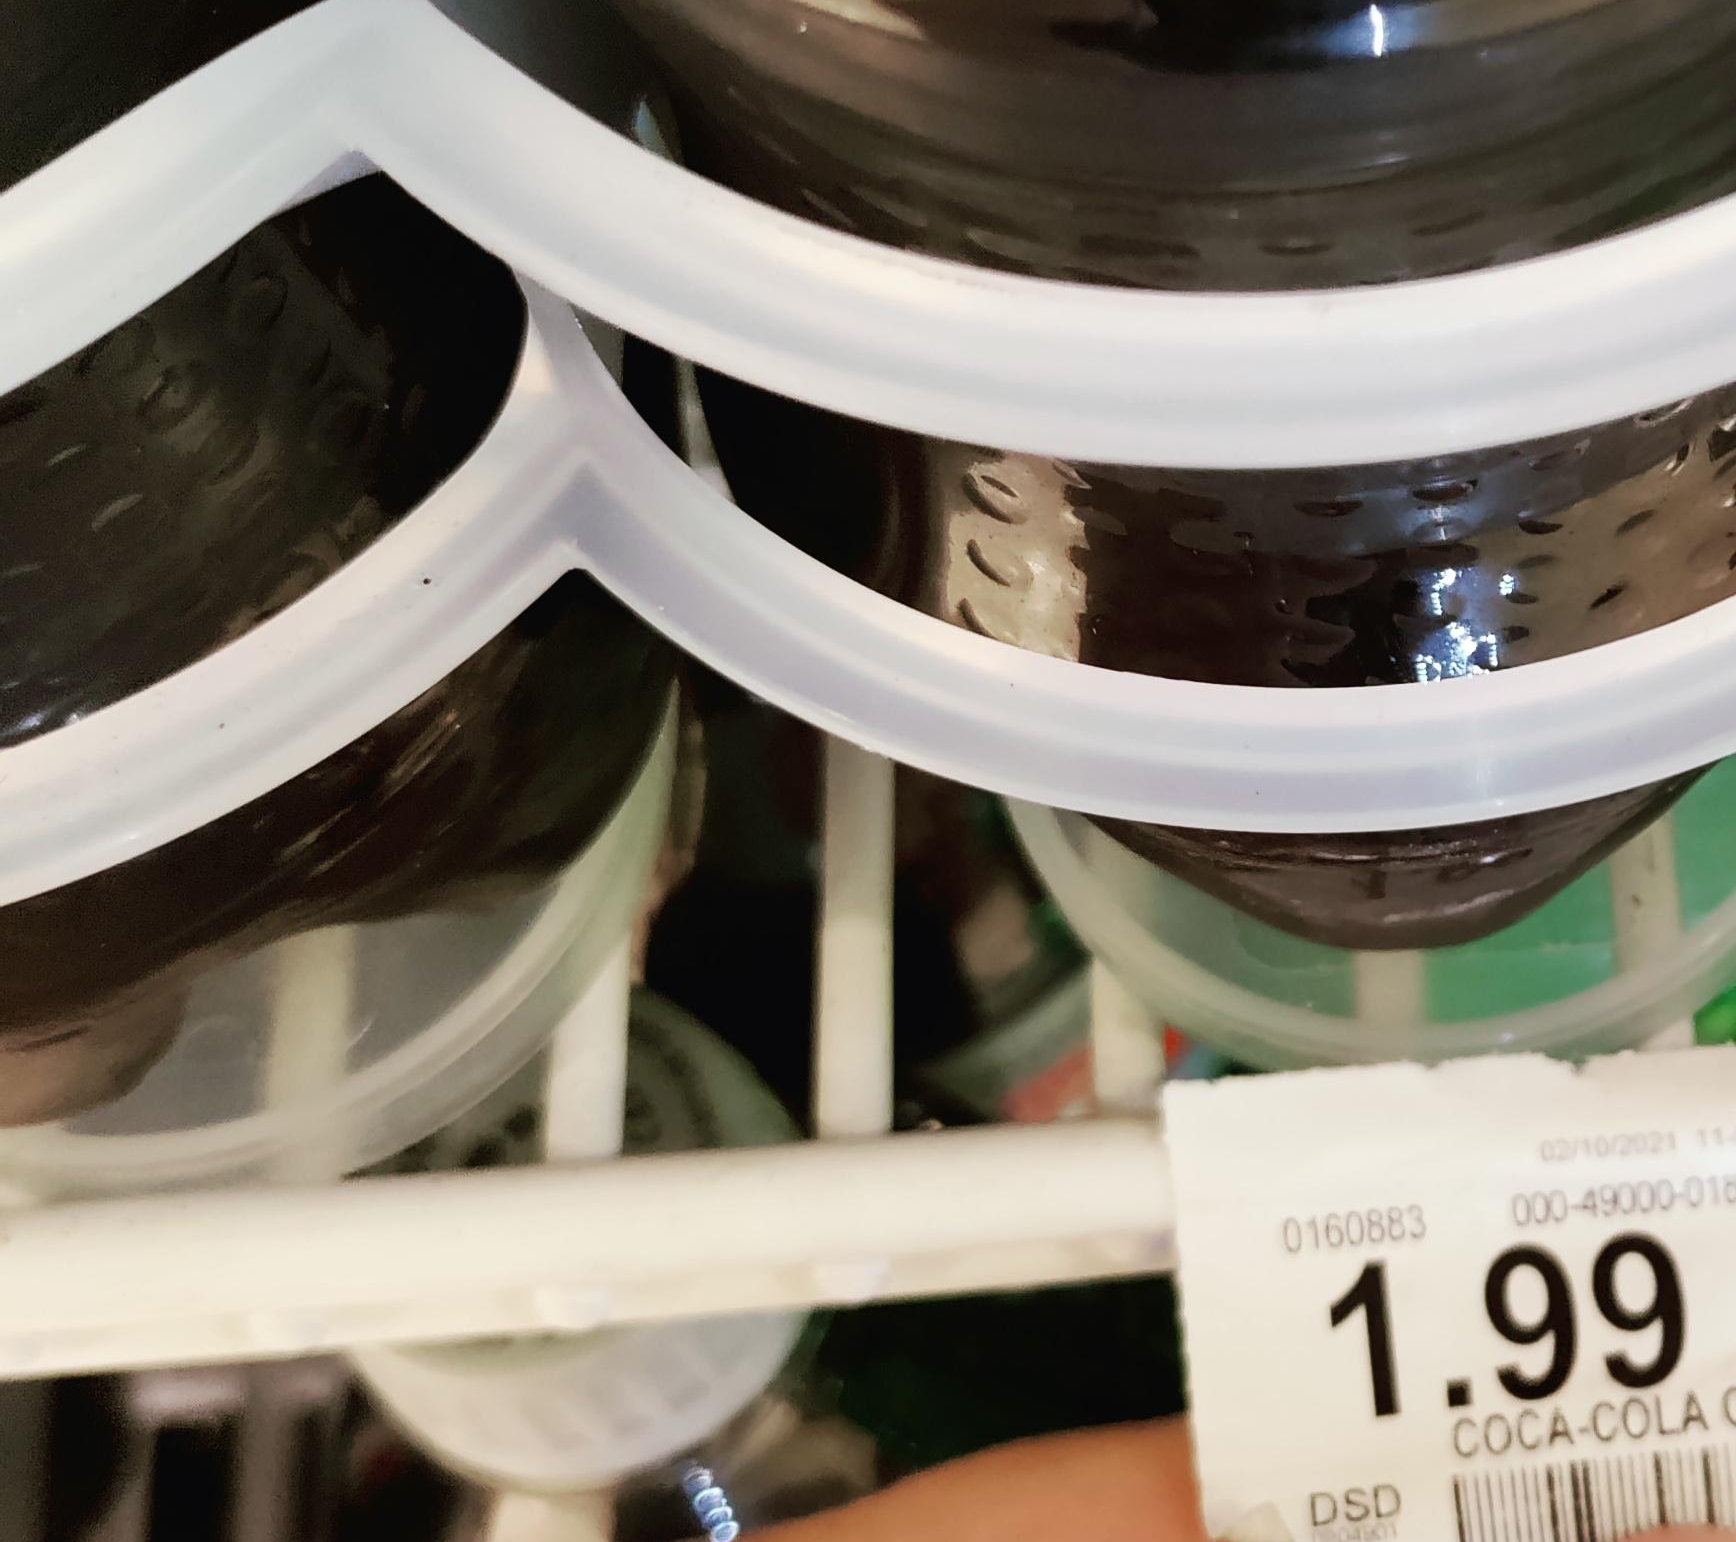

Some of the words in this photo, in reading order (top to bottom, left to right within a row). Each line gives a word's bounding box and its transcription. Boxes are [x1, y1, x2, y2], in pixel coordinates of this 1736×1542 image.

[1539, 1129, 1678, 1164] 02/10/2021
[1282, 1203, 1428, 1254] 0160883
[1328, 1229, 1689, 1419] 1.99
[1451, 1391, 1710, 1460] COCA-COLA
[1308, 1481, 1403, 1528] DSD
